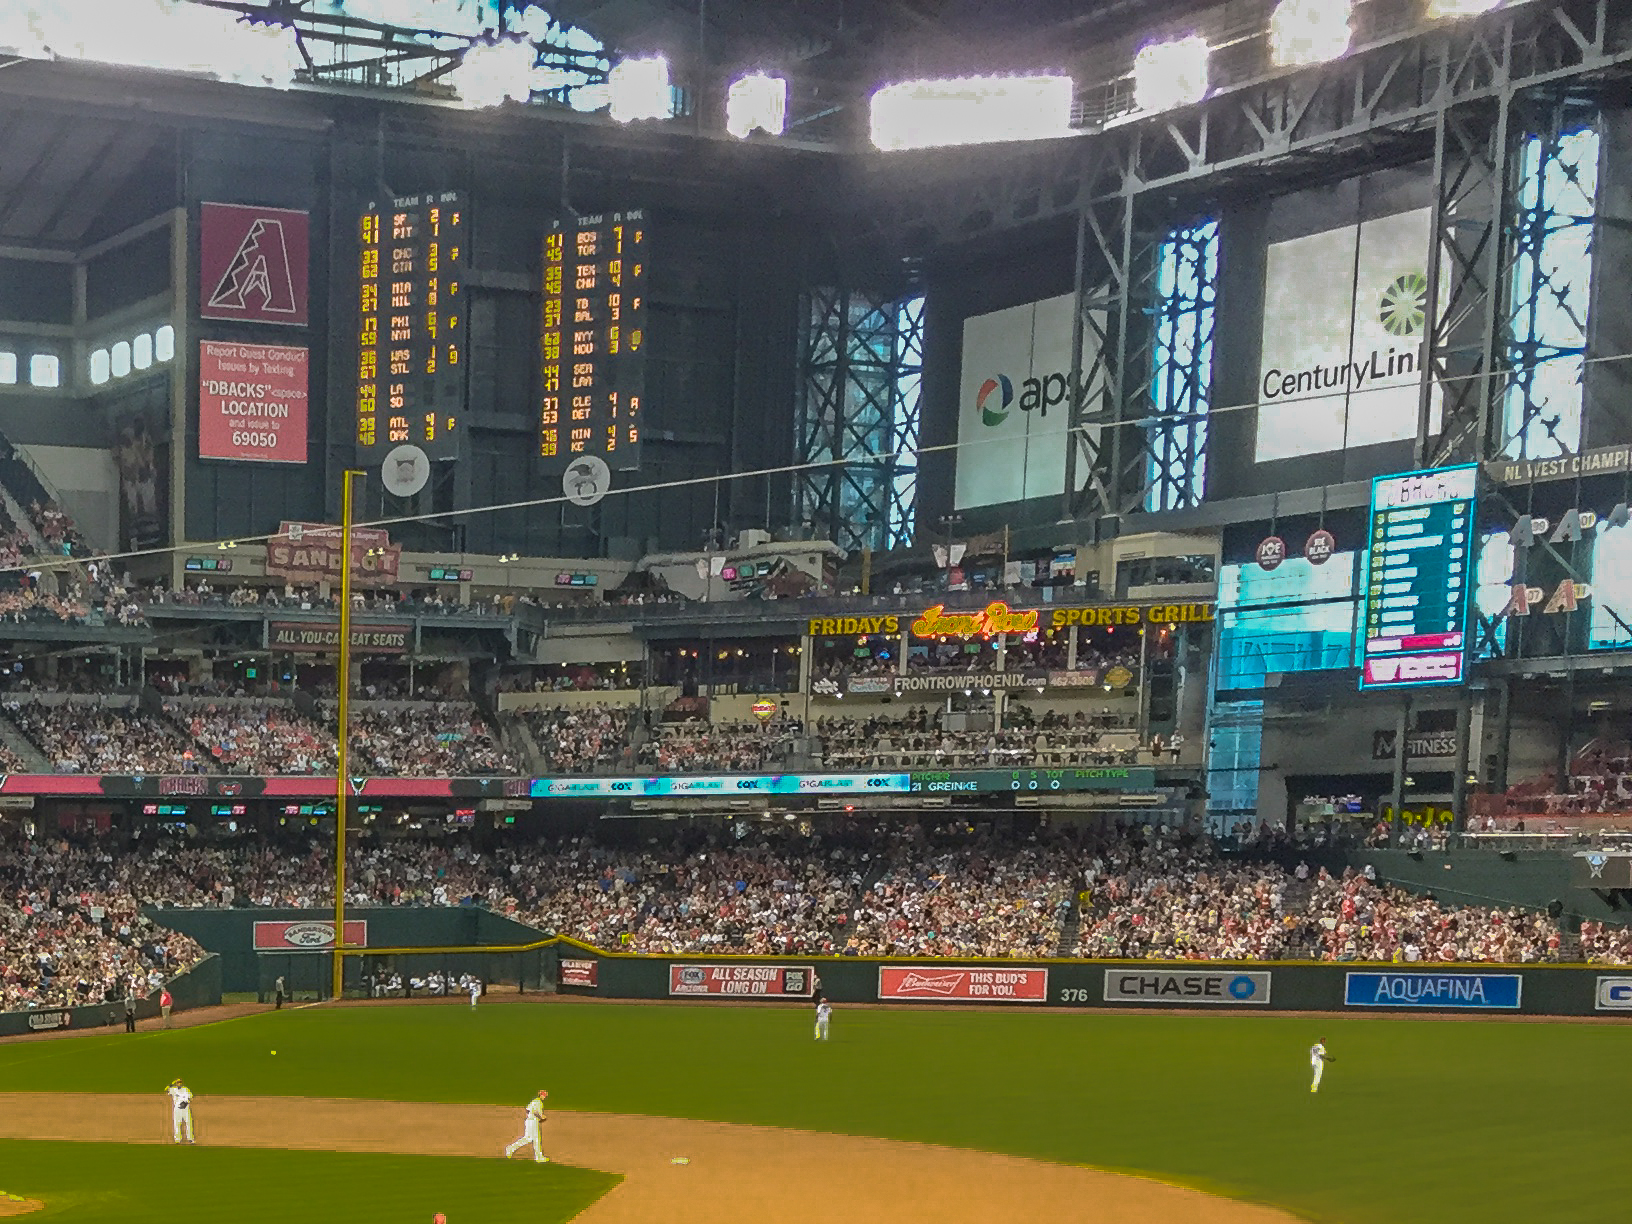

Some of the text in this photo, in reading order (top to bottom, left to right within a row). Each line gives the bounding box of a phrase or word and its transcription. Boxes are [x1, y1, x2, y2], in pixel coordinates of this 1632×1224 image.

[393, 197, 419, 208] TEAM
[393, 213, 407, 226] SF
[430, 208, 439, 223] 2
[578, 215, 603, 226] TEAM
[362, 229, 379, 244] 41
[393, 226, 413, 239] PIT
[547, 233, 563, 248] 41
[614, 226, 622, 240] 7
[547, 247, 562, 261] 45
[577, 245, 596, 257] TOR
[576, 264, 595, 277] TEX
[609, 260, 621, 274] 10
[361, 277, 437, 298] 34 MIA 4
[576, 278, 595, 289] CHW
[612, 274, 620, 287] 4
[361, 296, 411, 312] 27 MIL
[609, 294, 620, 307] 10
[611, 307, 619, 320] 3
[365, 317, 377, 331] 17
[391, 316, 409, 328] PHI
[391, 329, 411, 341] NYM
[428, 326, 437, 340] 7
[574, 330, 594, 342] NYY
[207, 345, 306, 362] Report Guest Conduct
[390, 350, 411, 362] WAS
[573, 343, 594, 355] HOU
[218, 359, 295, 378] Issues by Texting
[390, 363, 410, 375] STL
[427, 360, 436, 374] 2
[544, 363, 593, 378] 44 SEA
[1263, 342, 1424, 398] CenturyLin
[202, 380, 272, 398] "DBACKS"
[360, 384, 404, 398] 44 LA
[221, 400, 289, 418] LOCATION
[543, 392, 617, 411] 37 CLE 4
[389, 417, 409, 428] ATL
[426, 413, 435, 426] 4
[542, 410, 558, 424] 53
[571, 408, 591, 420] DET
[229, 419, 245, 429] and
[232, 431, 277, 448] 69050
[389, 427, 434, 442] OAK 3
[571, 428, 591, 440] MIN
[571, 441, 585, 452] KC
[607, 438, 616, 452] 2
[1504, 449, 1632, 481] NL WEST CHAMPI
[274, 546, 396, 571] SANDLOT
[809, 616, 899, 635] FRIDAY'S
[1051, 607, 1140, 626] SPORTS
[1148, 604, 1215, 623] GRILL
[276, 630, 405, 647] ALL-YOU-CA-EAT SEATS
[894, 674, 1047, 692] FRONTROWPHOENIX.com
[912, 772, 950, 780] PITCHER
[1075, 770, 1104, 778] PITCH
[1106, 769, 1129, 778] TYPE
[611, 782, 633, 791] COX
[736, 780, 759, 789] COX
[867, 778, 890, 787] COX
[911, 783, 922, 791] 21
[928, 781, 977, 792] GREINKE
[287, 926, 334, 939] SANDERSON
[299, 932, 321, 944] Ford
[684, 970, 700, 979] FOX
[711, 967, 778, 981] ALL SEASON
[905, 974, 957, 989] Budweiser
[969, 972, 1028, 985] THIS BUD'S
[674, 984, 708, 993] ARIZONA
[720, 981, 768, 994] LONG ON
[969, 984, 1017, 997] FOR YOU.
[1118, 976, 1223, 996] CHASE
[1374, 976, 1488, 1004] AQUAFINA
[1060, 988, 1088, 1003] 376
